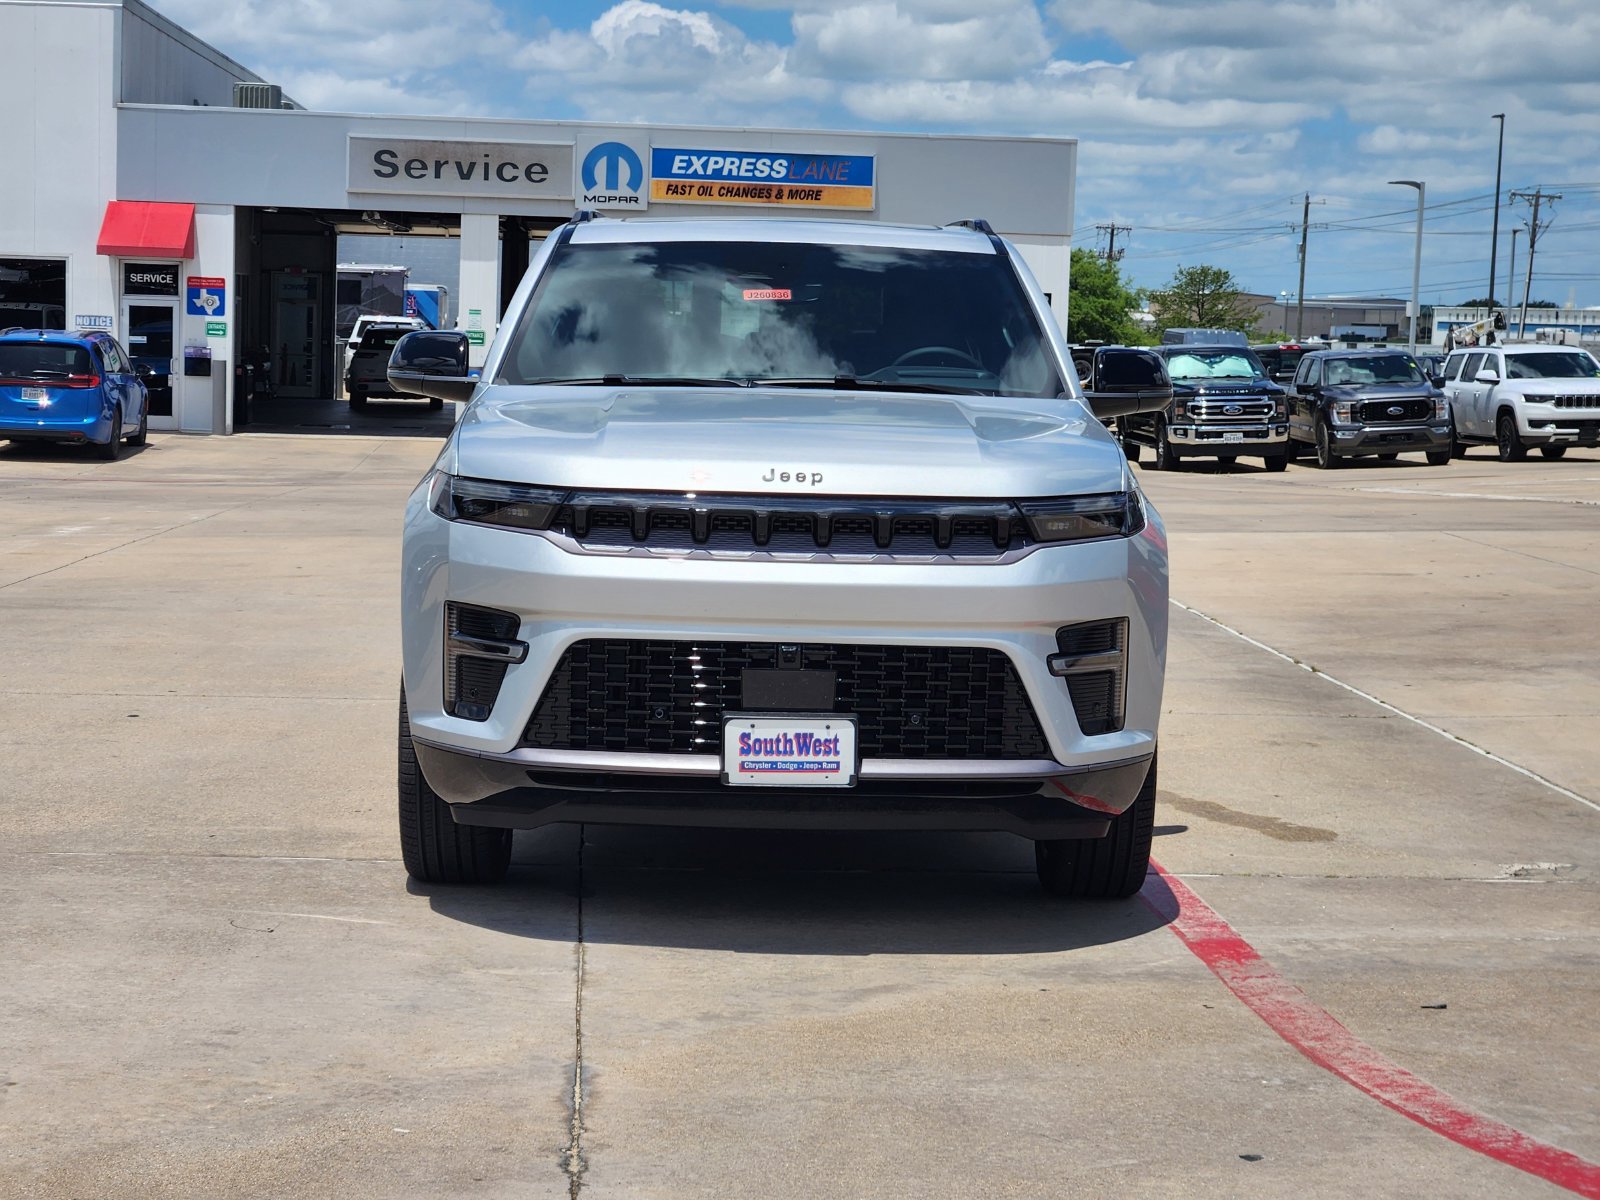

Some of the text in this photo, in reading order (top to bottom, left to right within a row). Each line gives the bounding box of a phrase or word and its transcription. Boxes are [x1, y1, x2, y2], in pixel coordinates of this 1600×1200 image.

[373, 149, 549, 183] Service
[665, 184, 823, 201] FAST OIL CHANGES & MORE
[583, 195, 640, 205] MOPAR
[130, 273, 174, 284] SERVICE
[747, 291, 789, 299] J260836
[76, 316, 112, 326] NOTICE
[762, 468, 823, 486] Jeep
[738, 731, 840, 757] SouthWest
[744, 761, 837, 771] Chrysler Dodge Jeep Ram
